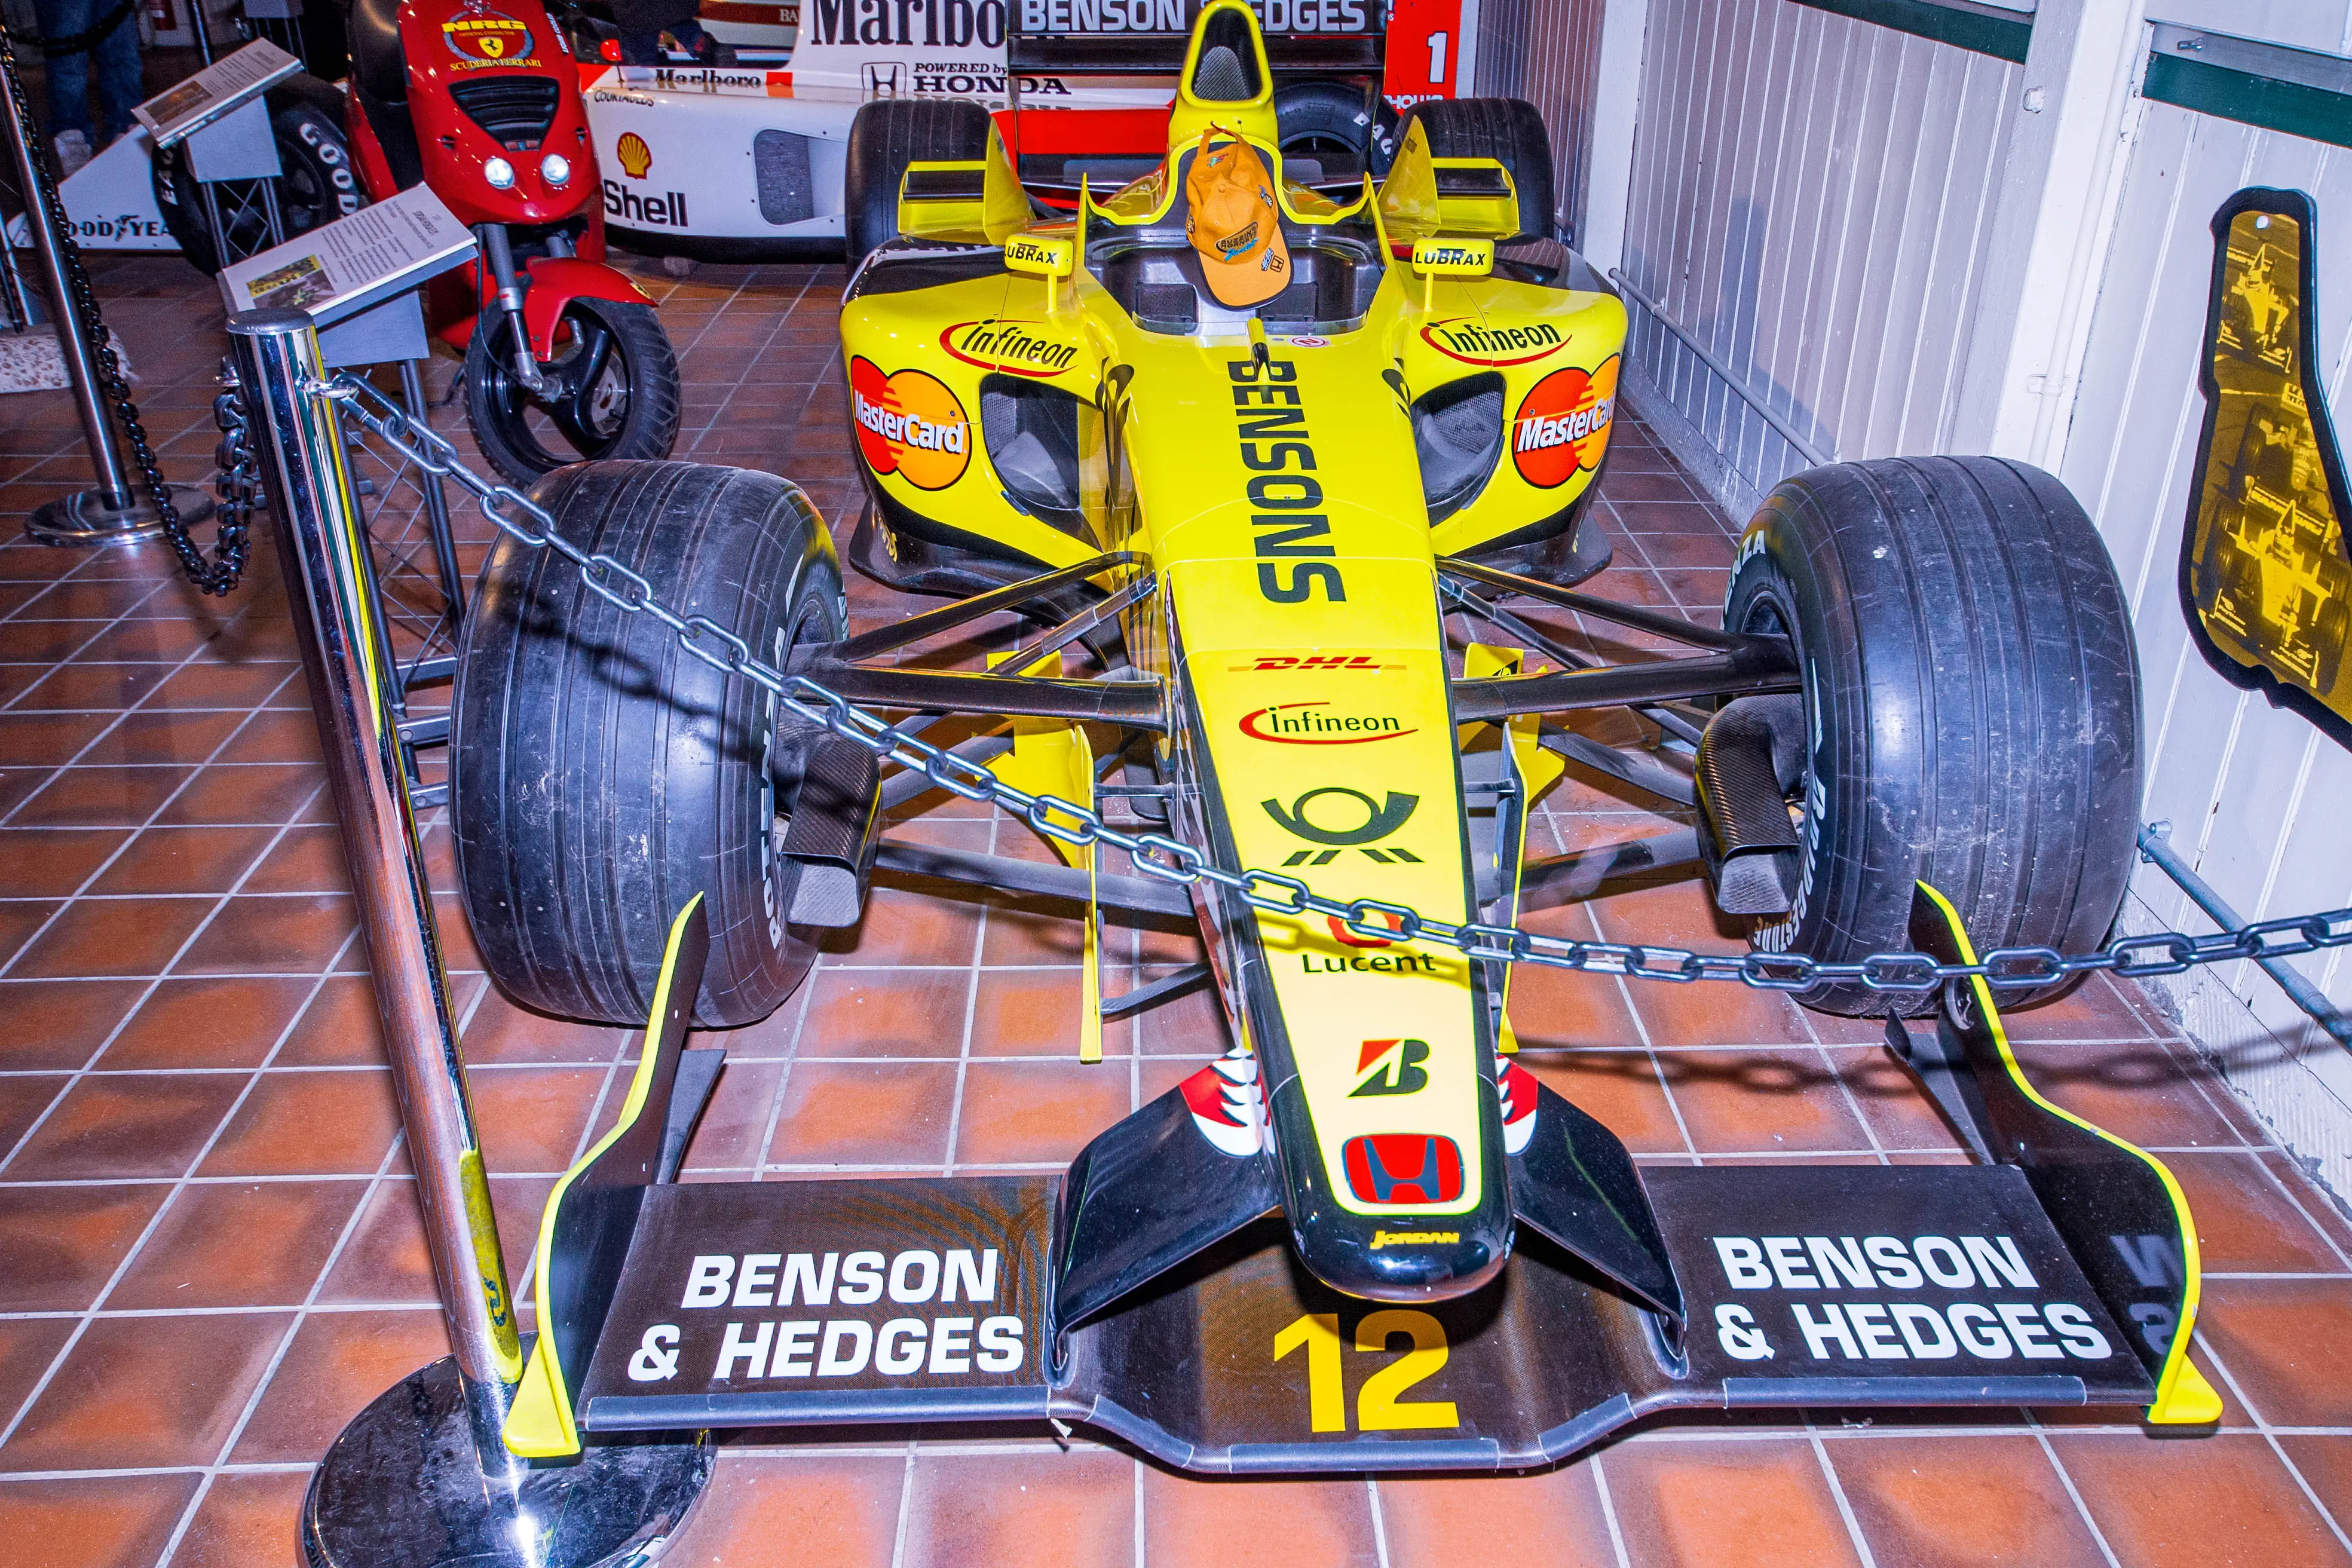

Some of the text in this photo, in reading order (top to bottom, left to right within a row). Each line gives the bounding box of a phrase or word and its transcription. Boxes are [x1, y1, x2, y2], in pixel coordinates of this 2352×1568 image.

[442, 20, 527, 32] NRG
[811, 0, 1006, 47] Marlbo
[1021, 0, 1185, 31] BENSON
[450, 58, 542, 71] SCUDERIA FERRARI
[914, 63, 990, 74] POWERED
[1428, 32, 1447, 83] 1
[656, 69, 761, 88] Marlboro
[914, 76, 1072, 94] HONDA
[604, 180, 688, 227] Shell
[1004, 243, 1057, 264] UBRAX
[1415, 248, 1486, 267] LUBRAX
[855, 390, 965, 454] MasterCard
[1227, 360, 1347, 604] BENSONS
[1254, 657, 1382, 670] DHL
[1302, 953, 1437, 973] Lucent
[681, 1248, 999, 1309] BENSON
[1713, 1236, 2040, 1289] BENSON
[627, 1316, 1024, 1382] & HEDGES
[1714, 1303, 1775, 1359] &
[1792, 1303, 2113, 1359] HEDGES
[1274, 1309, 1460, 1433] 12
